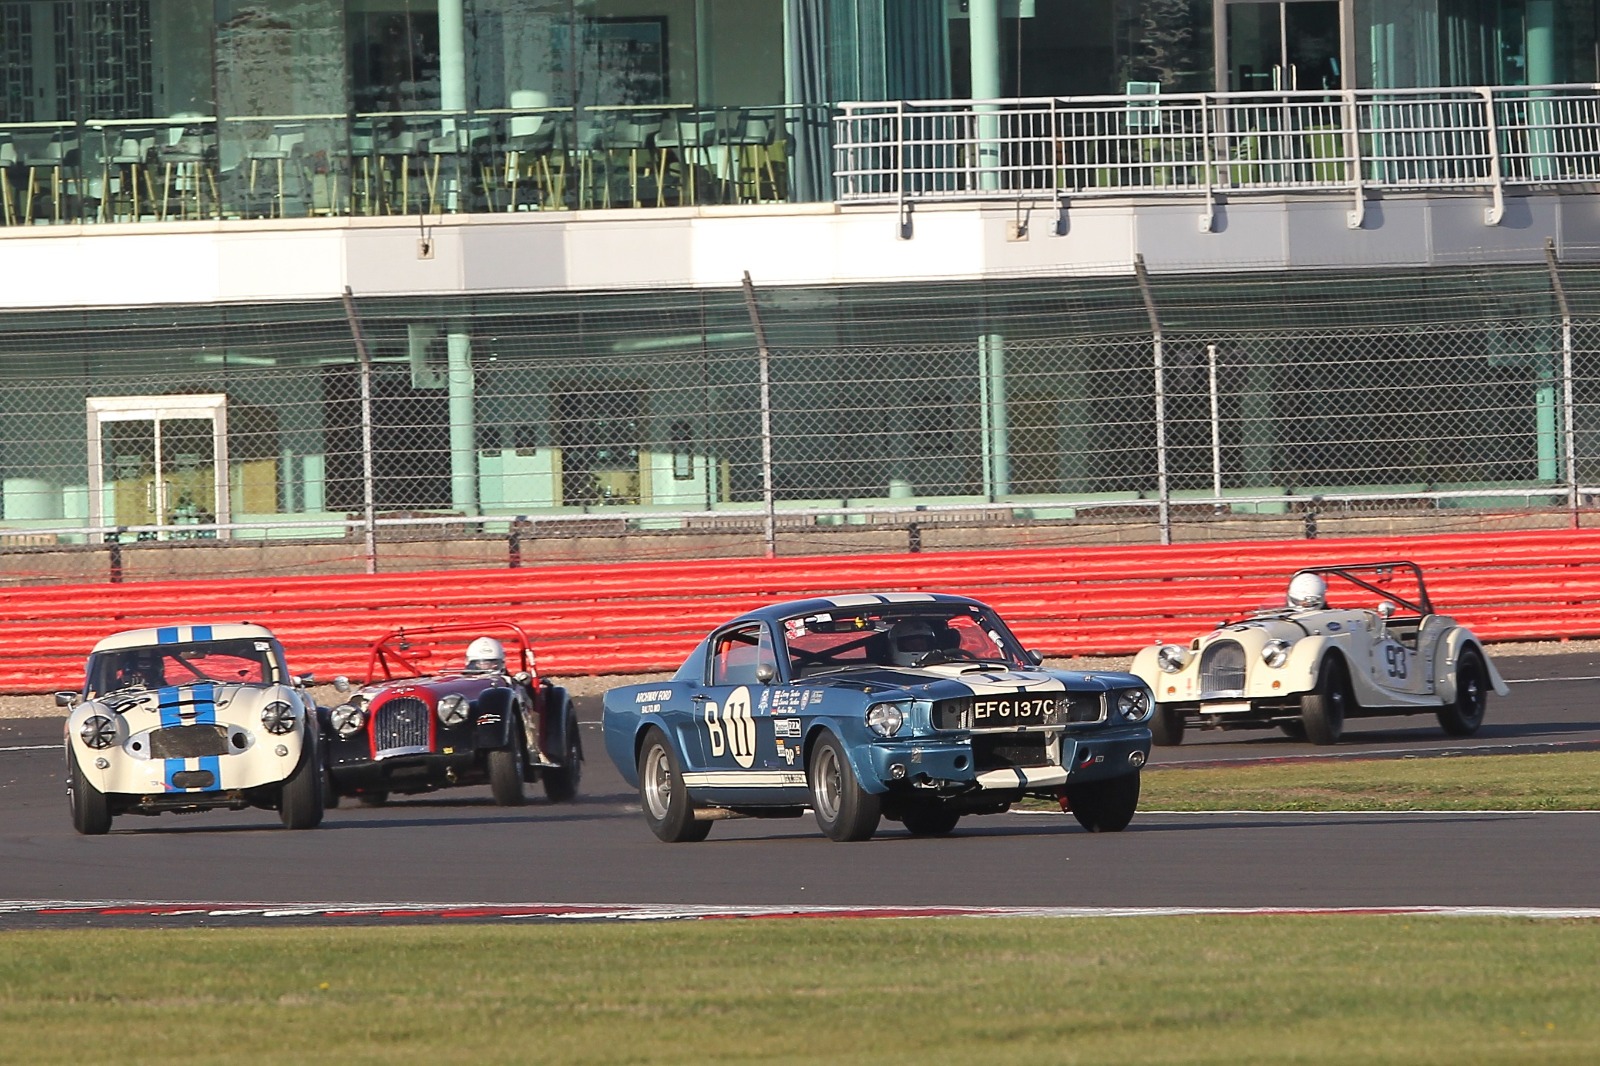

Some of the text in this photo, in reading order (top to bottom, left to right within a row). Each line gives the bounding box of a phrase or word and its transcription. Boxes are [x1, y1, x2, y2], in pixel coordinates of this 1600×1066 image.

[1386, 645, 1407, 679] 93
[635, 690, 672, 703] ARCHWAY FORD
[975, 700, 1054, 718] EFG 137C
[705, 702, 752, 757] B 11
